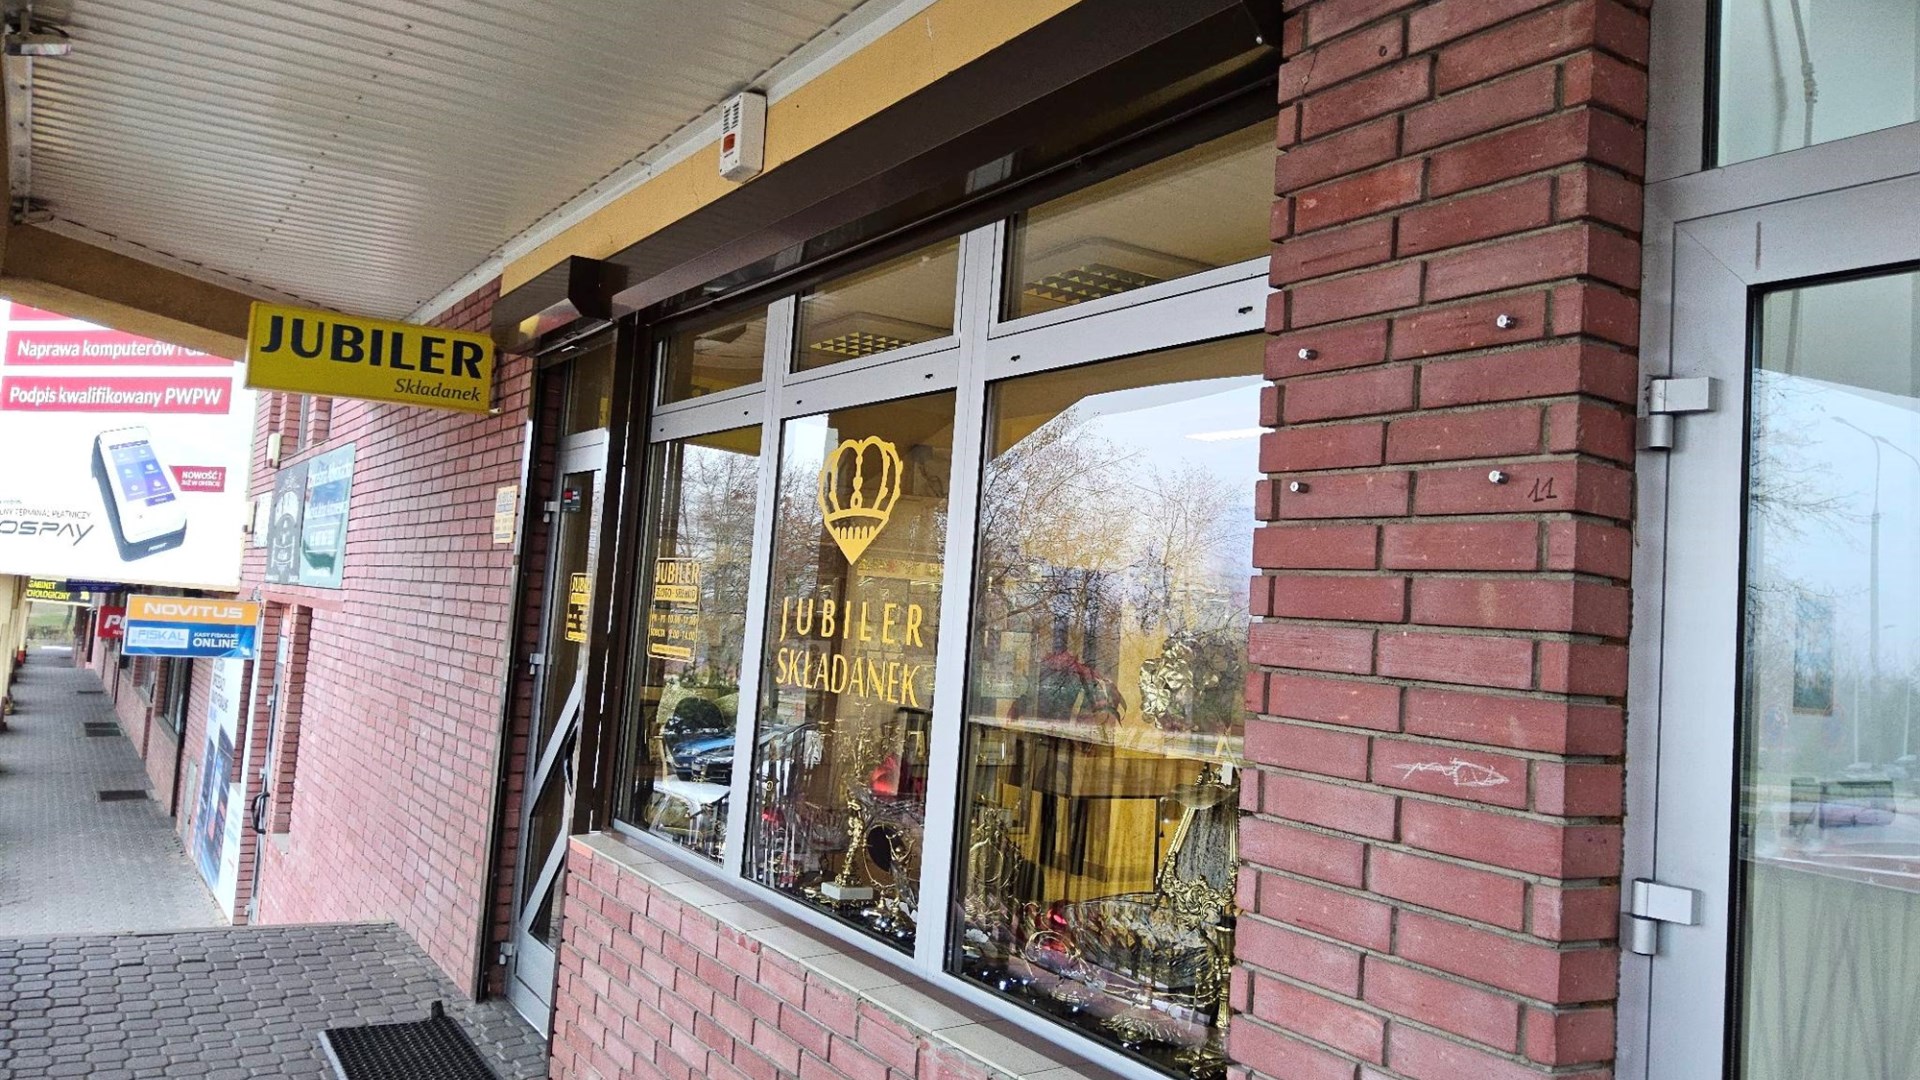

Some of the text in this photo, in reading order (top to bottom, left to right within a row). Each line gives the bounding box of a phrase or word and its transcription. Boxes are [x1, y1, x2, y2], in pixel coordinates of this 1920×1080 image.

[17, 339, 80, 360] Naprawa
[82, 339, 176, 360] komputerów
[260, 315, 484, 379] JUBILER
[10, 386, 222, 408] Podpis kwalifikowany PWPW
[394, 378, 481, 402] Składanek
[182, 470, 217, 480] NOWOŚĆ
[1528, 477, 1557, 502] 11
[655, 562, 700, 584] JUBILER
[28, 580, 57, 590] GABINET
[143, 602, 243, 618] NOVITUS
[778, 597, 924, 648] JUBILER
[138, 629, 185, 641] FISKAL
[193, 637, 239, 648] ONLINE
[775, 647, 921, 708] SKŁADANEK
